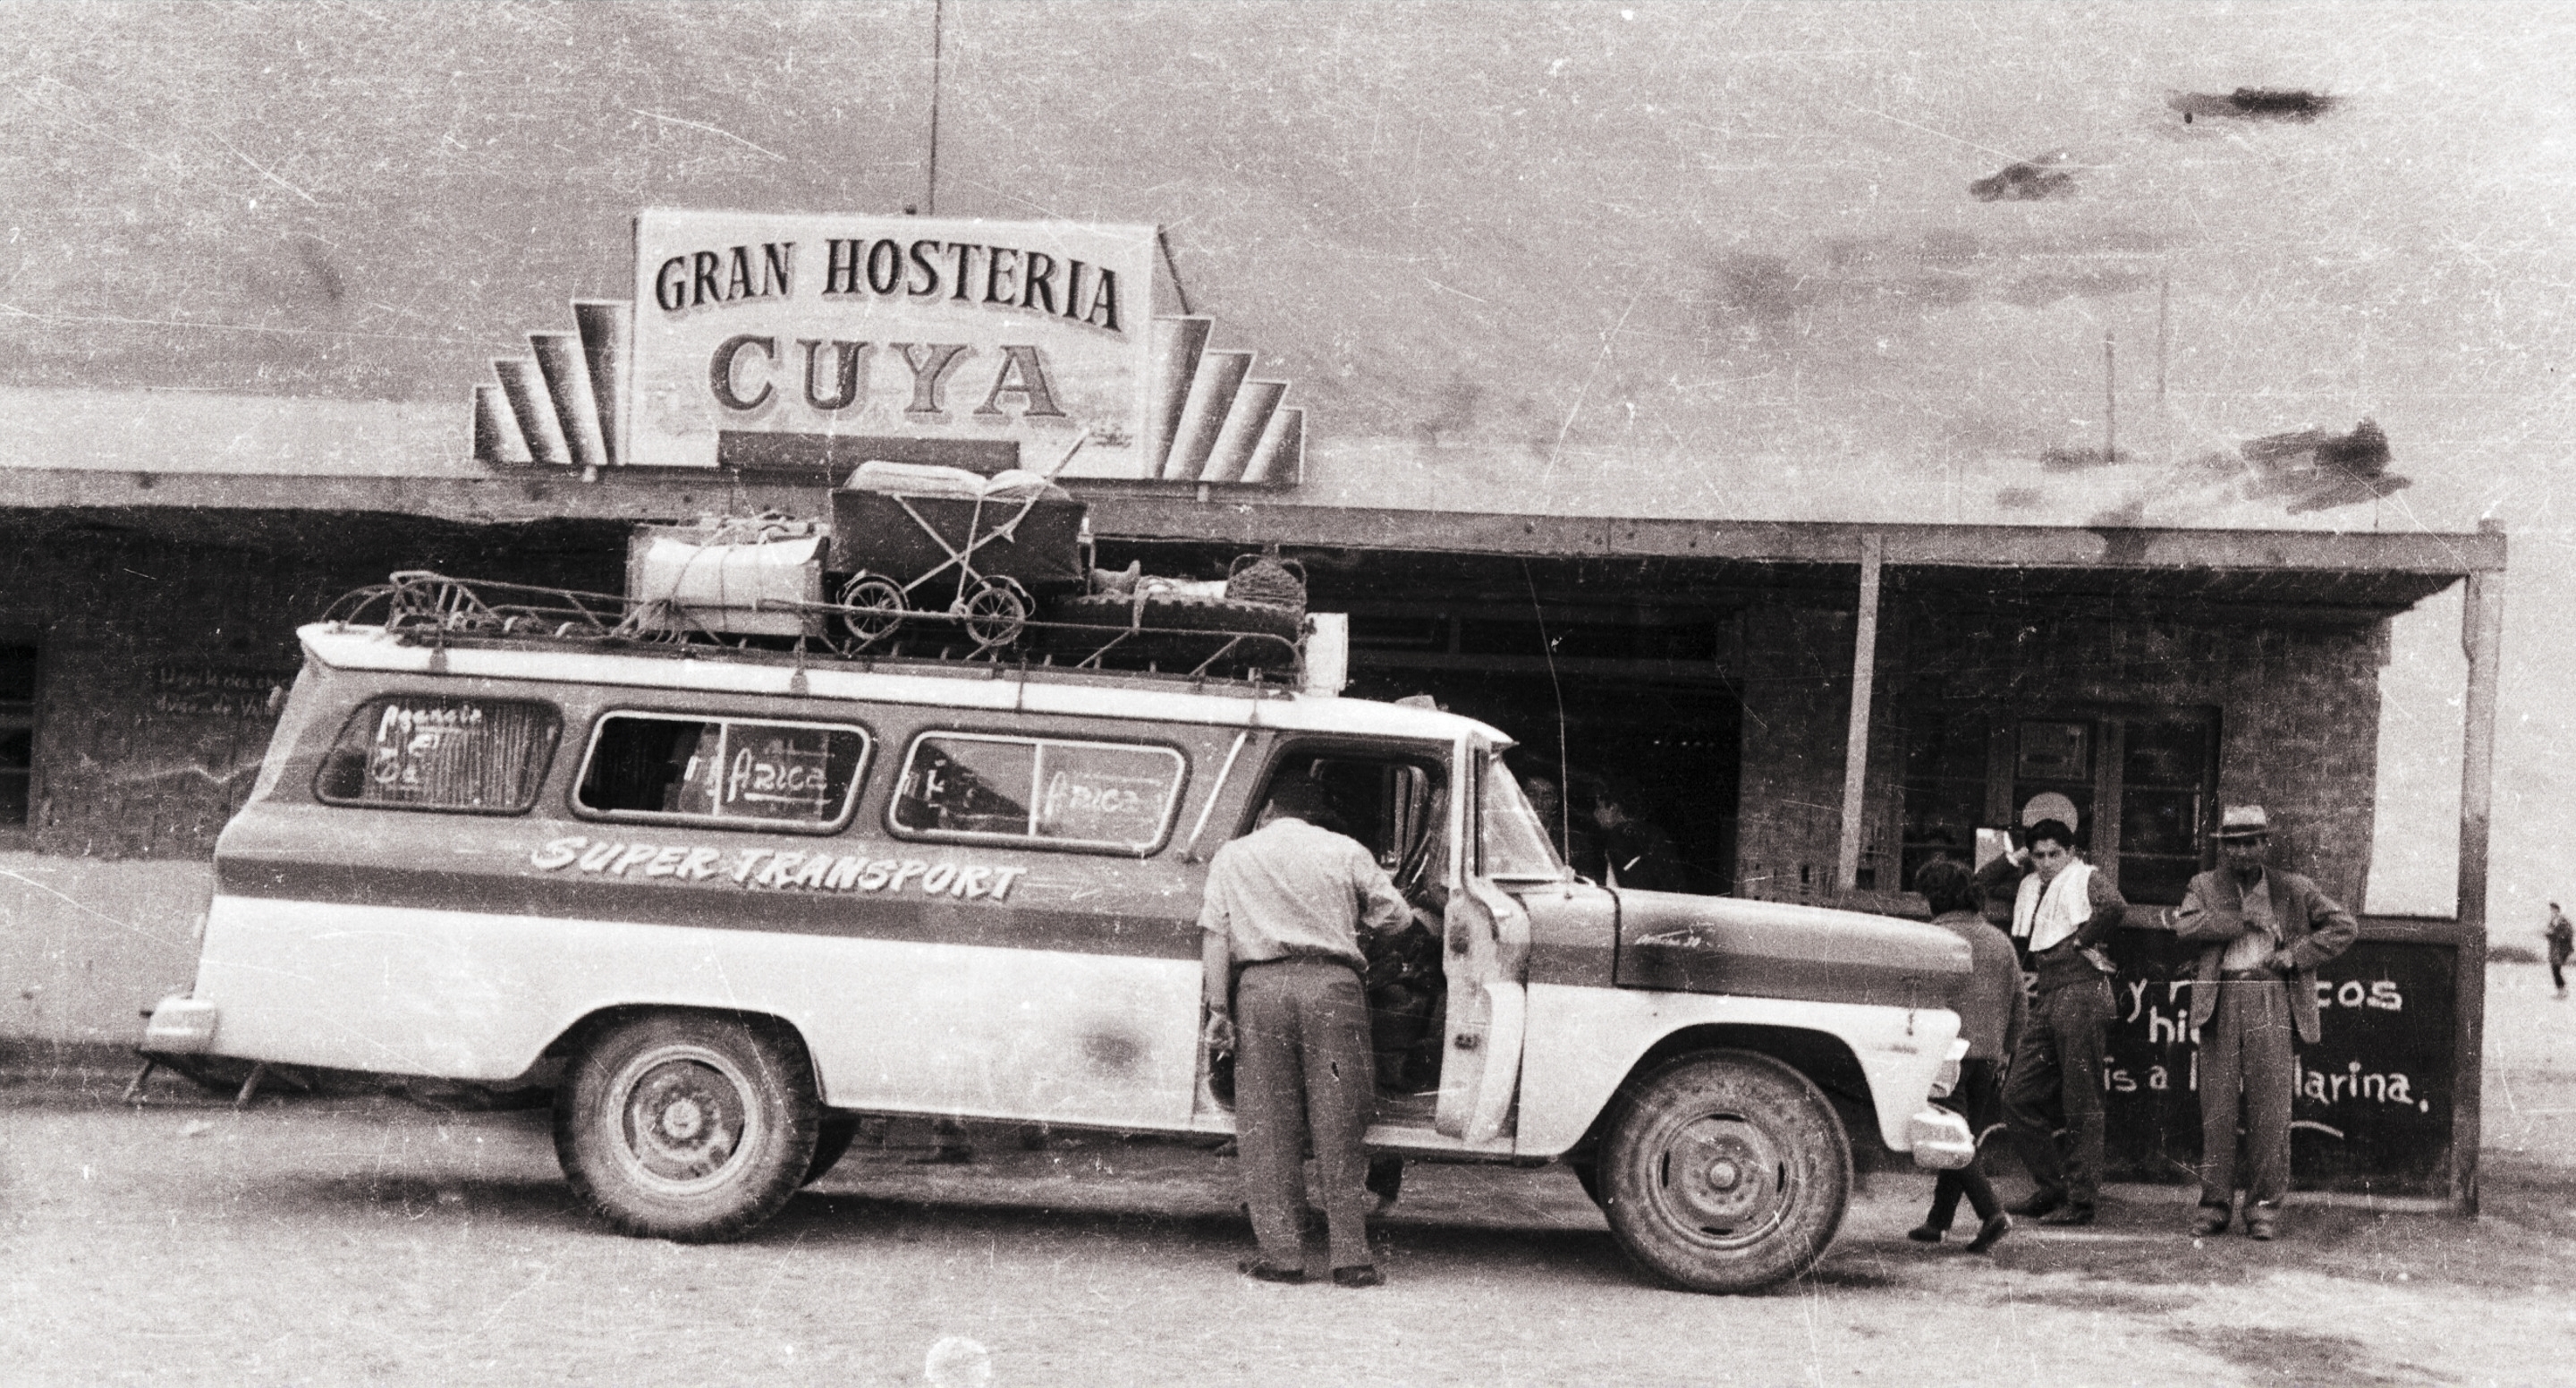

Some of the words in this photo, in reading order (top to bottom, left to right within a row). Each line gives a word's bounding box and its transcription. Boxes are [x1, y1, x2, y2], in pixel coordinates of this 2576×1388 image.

[656, 241, 798, 313] GRAN
[820, 238, 1123, 334] HOSTERIA
[709, 333, 1069, 420] CUYA
[530, 834, 724, 882] SUPER
[730, 847, 1029, 903] TRANSPORT
